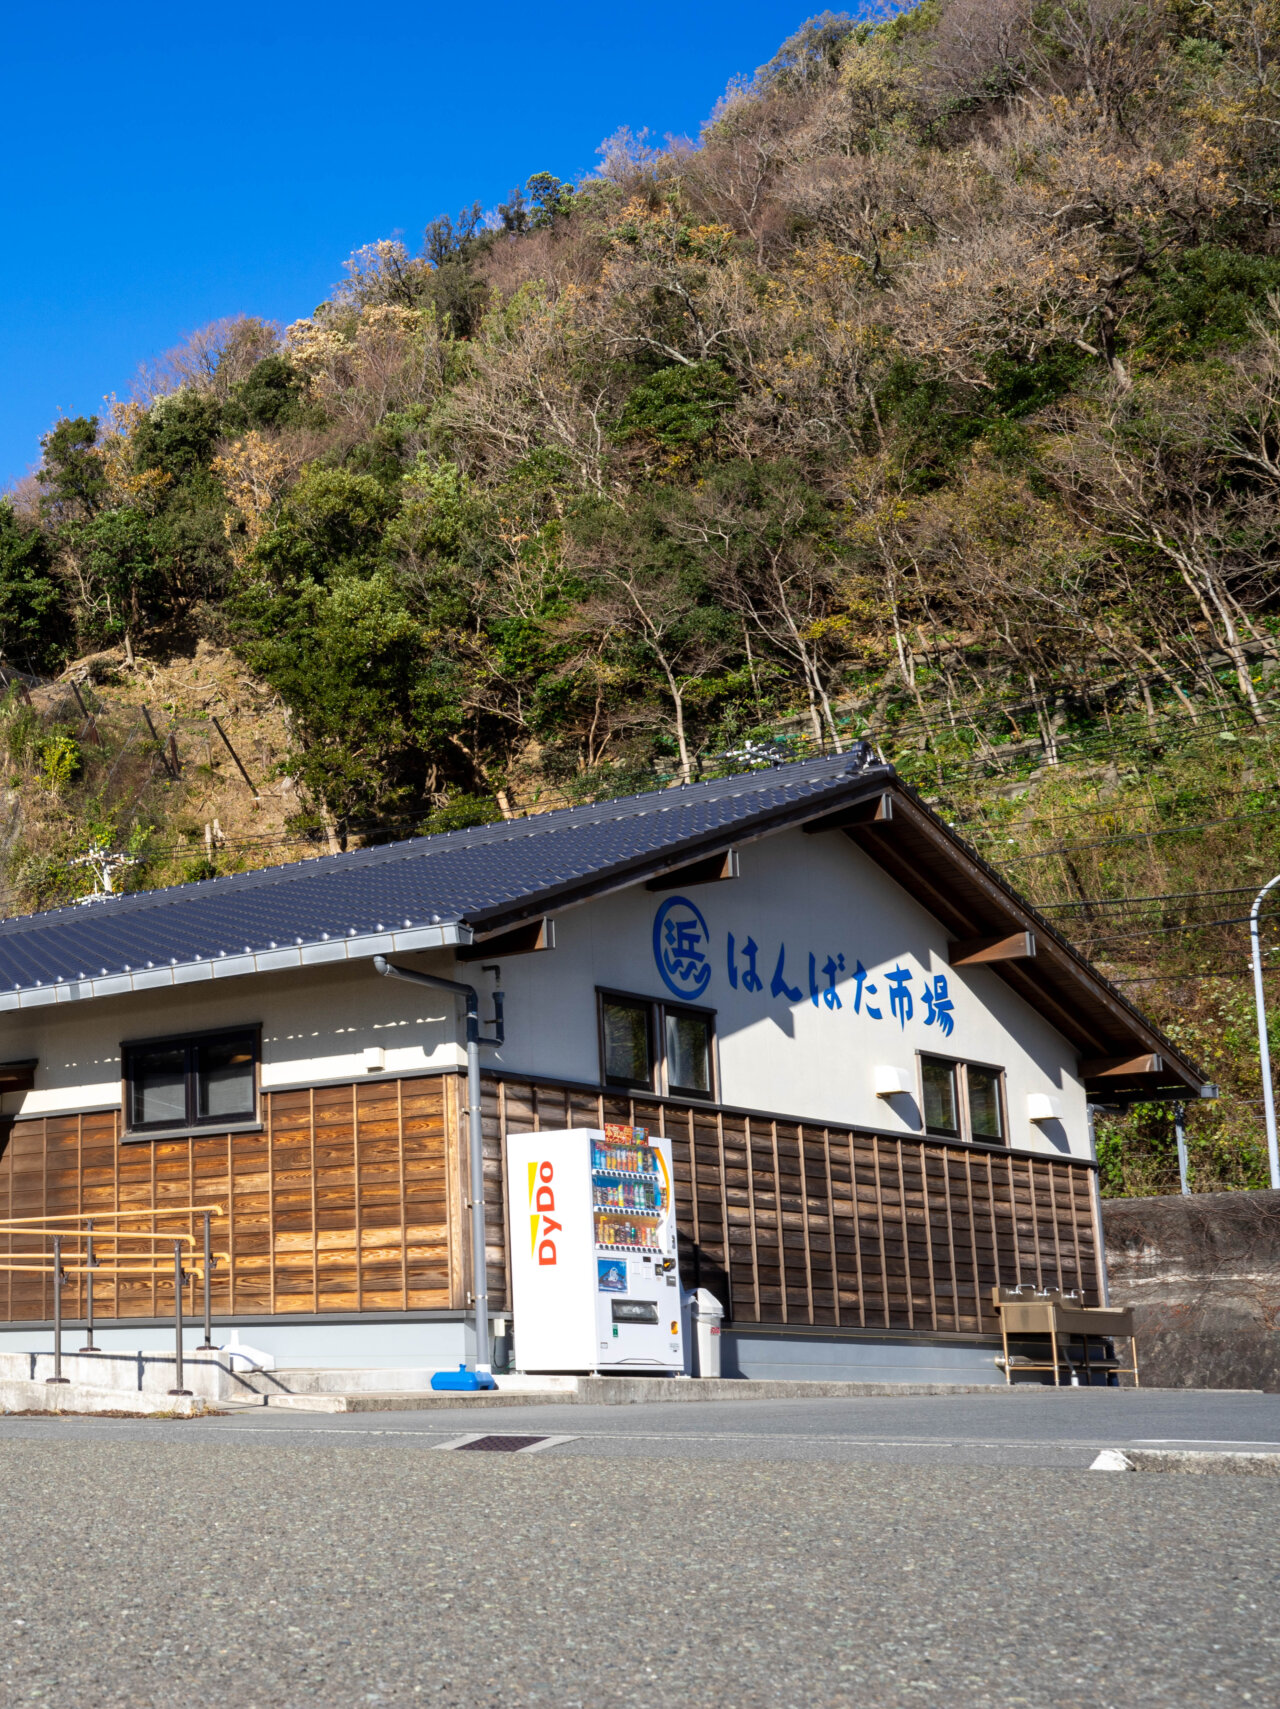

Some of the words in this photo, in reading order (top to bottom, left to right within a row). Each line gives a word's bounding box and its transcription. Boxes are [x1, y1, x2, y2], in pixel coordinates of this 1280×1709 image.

[727, 931, 955, 1038] はんばた市場
[536, 1161, 562, 1265] DyDo
